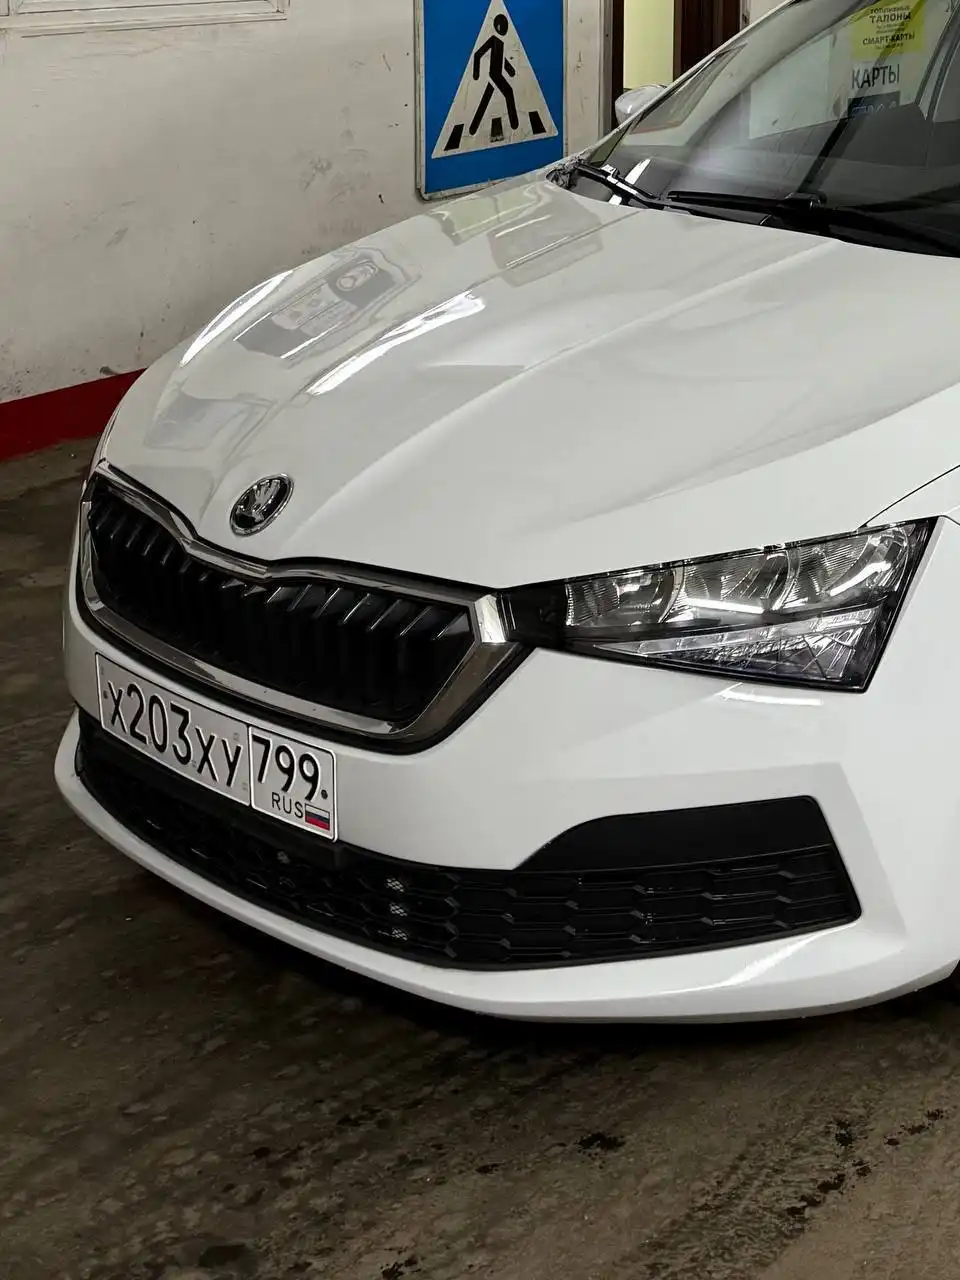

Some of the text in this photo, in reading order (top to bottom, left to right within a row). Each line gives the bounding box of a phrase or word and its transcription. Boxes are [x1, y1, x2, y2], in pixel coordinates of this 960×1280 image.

[869, 12, 912, 24] ТАЛОНЫ
[851, 63, 900, 89] КАРТЫ
[252, 733, 321, 802] 799
[271, 792, 304, 819] RUS
